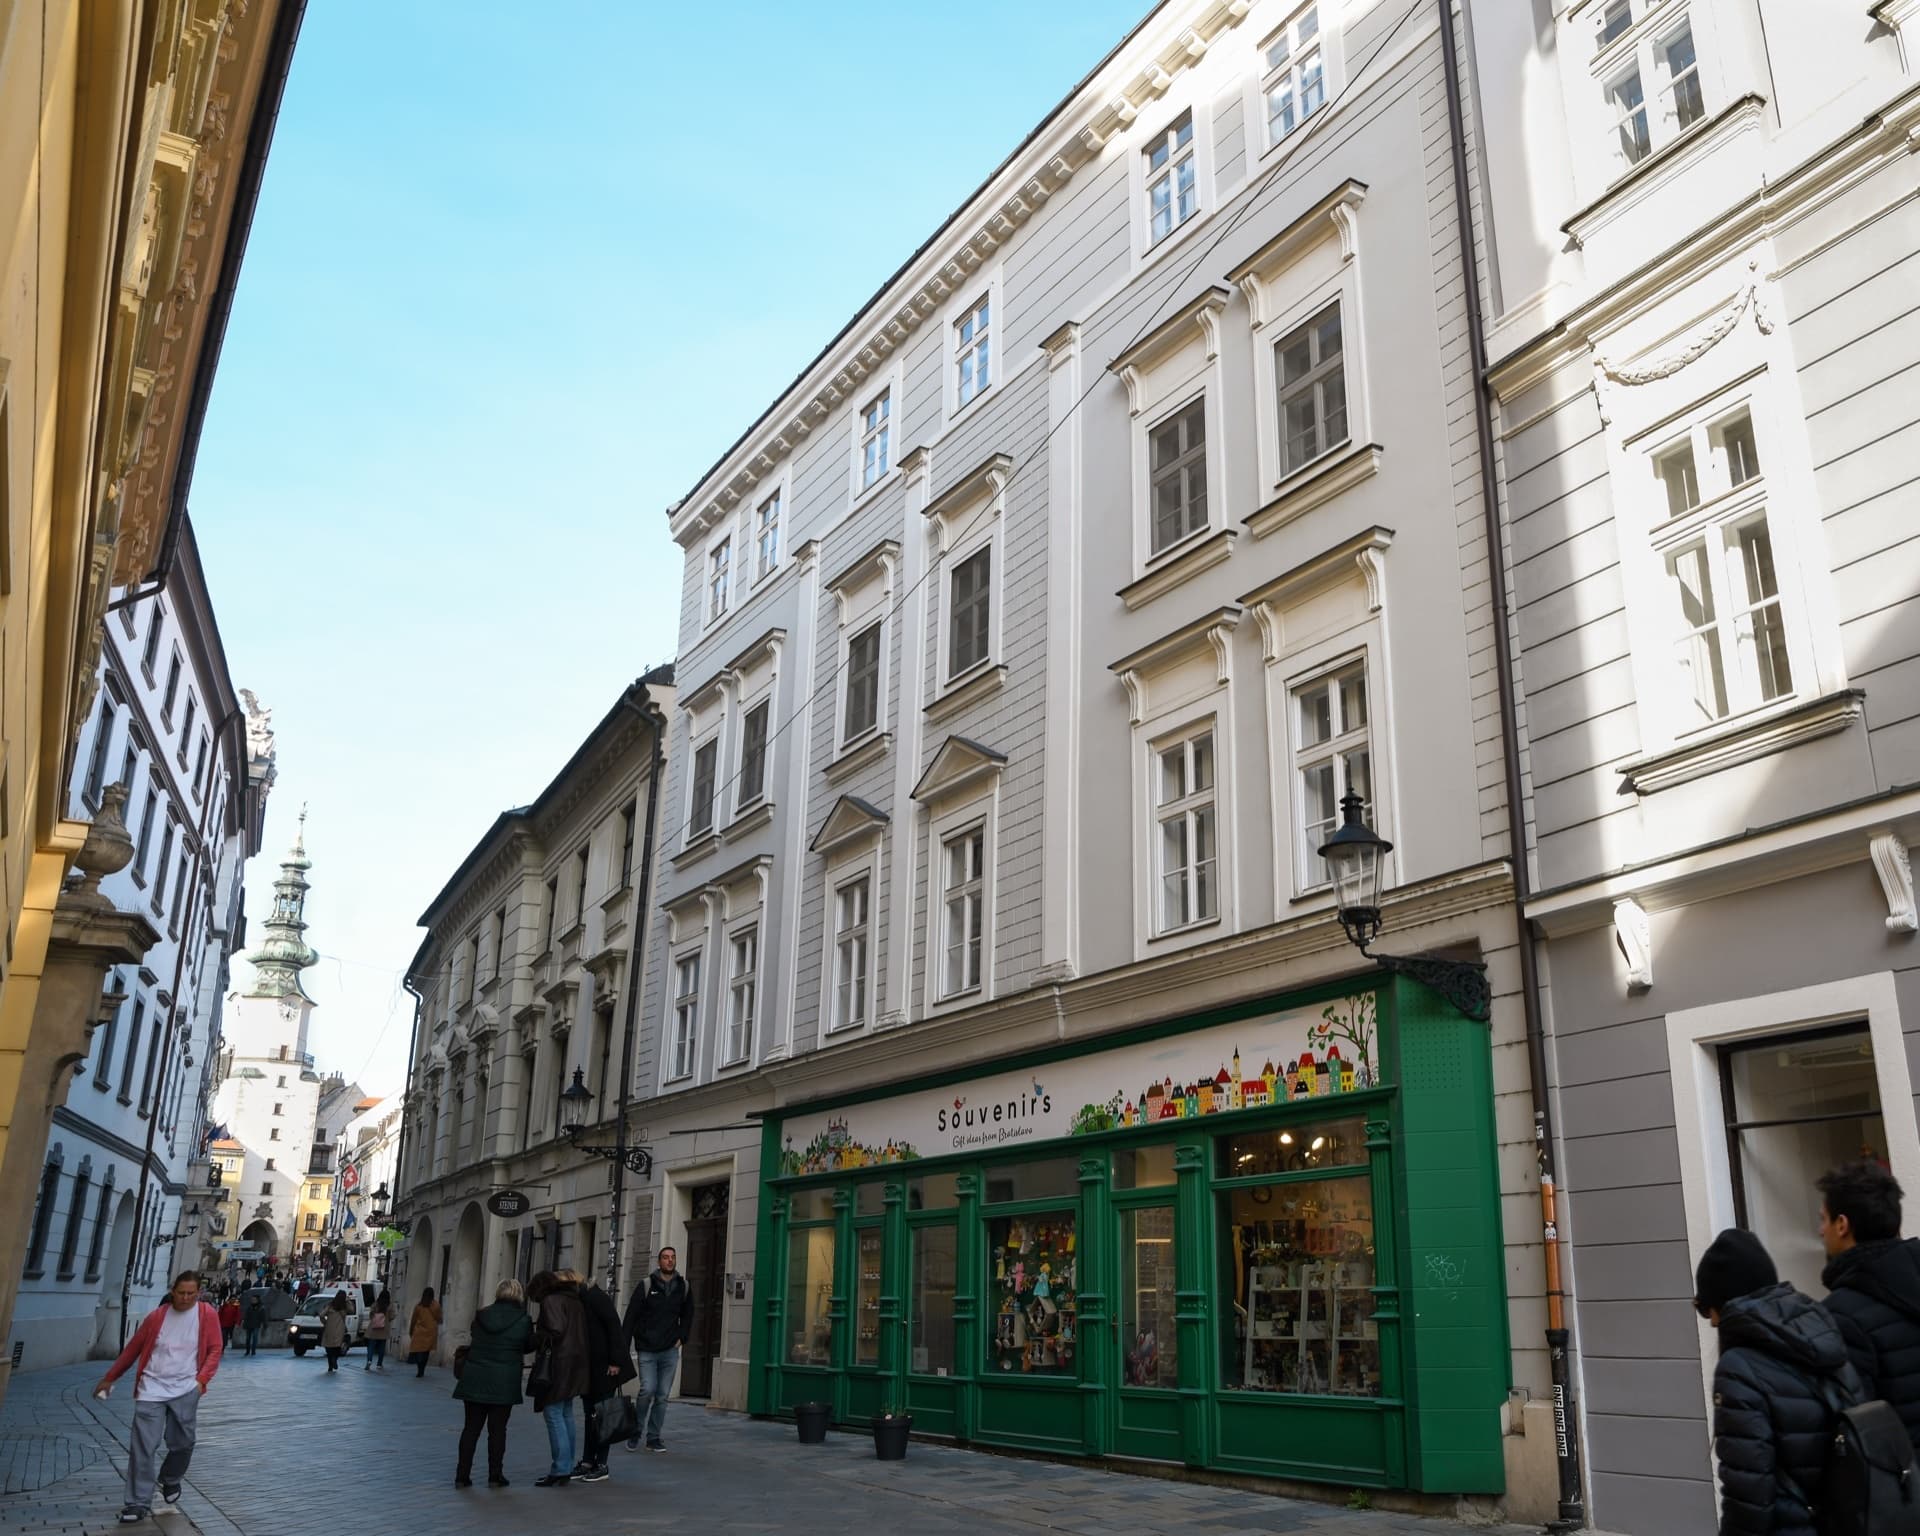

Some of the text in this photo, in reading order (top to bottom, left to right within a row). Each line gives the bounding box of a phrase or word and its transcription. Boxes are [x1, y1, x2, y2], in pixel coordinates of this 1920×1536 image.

[938, 1093, 1051, 1131] Souvenirs
[952, 1135, 966, 1148] Gift
[981, 1130, 997, 1144] from
[999, 1125, 1032, 1142] Bratislava
